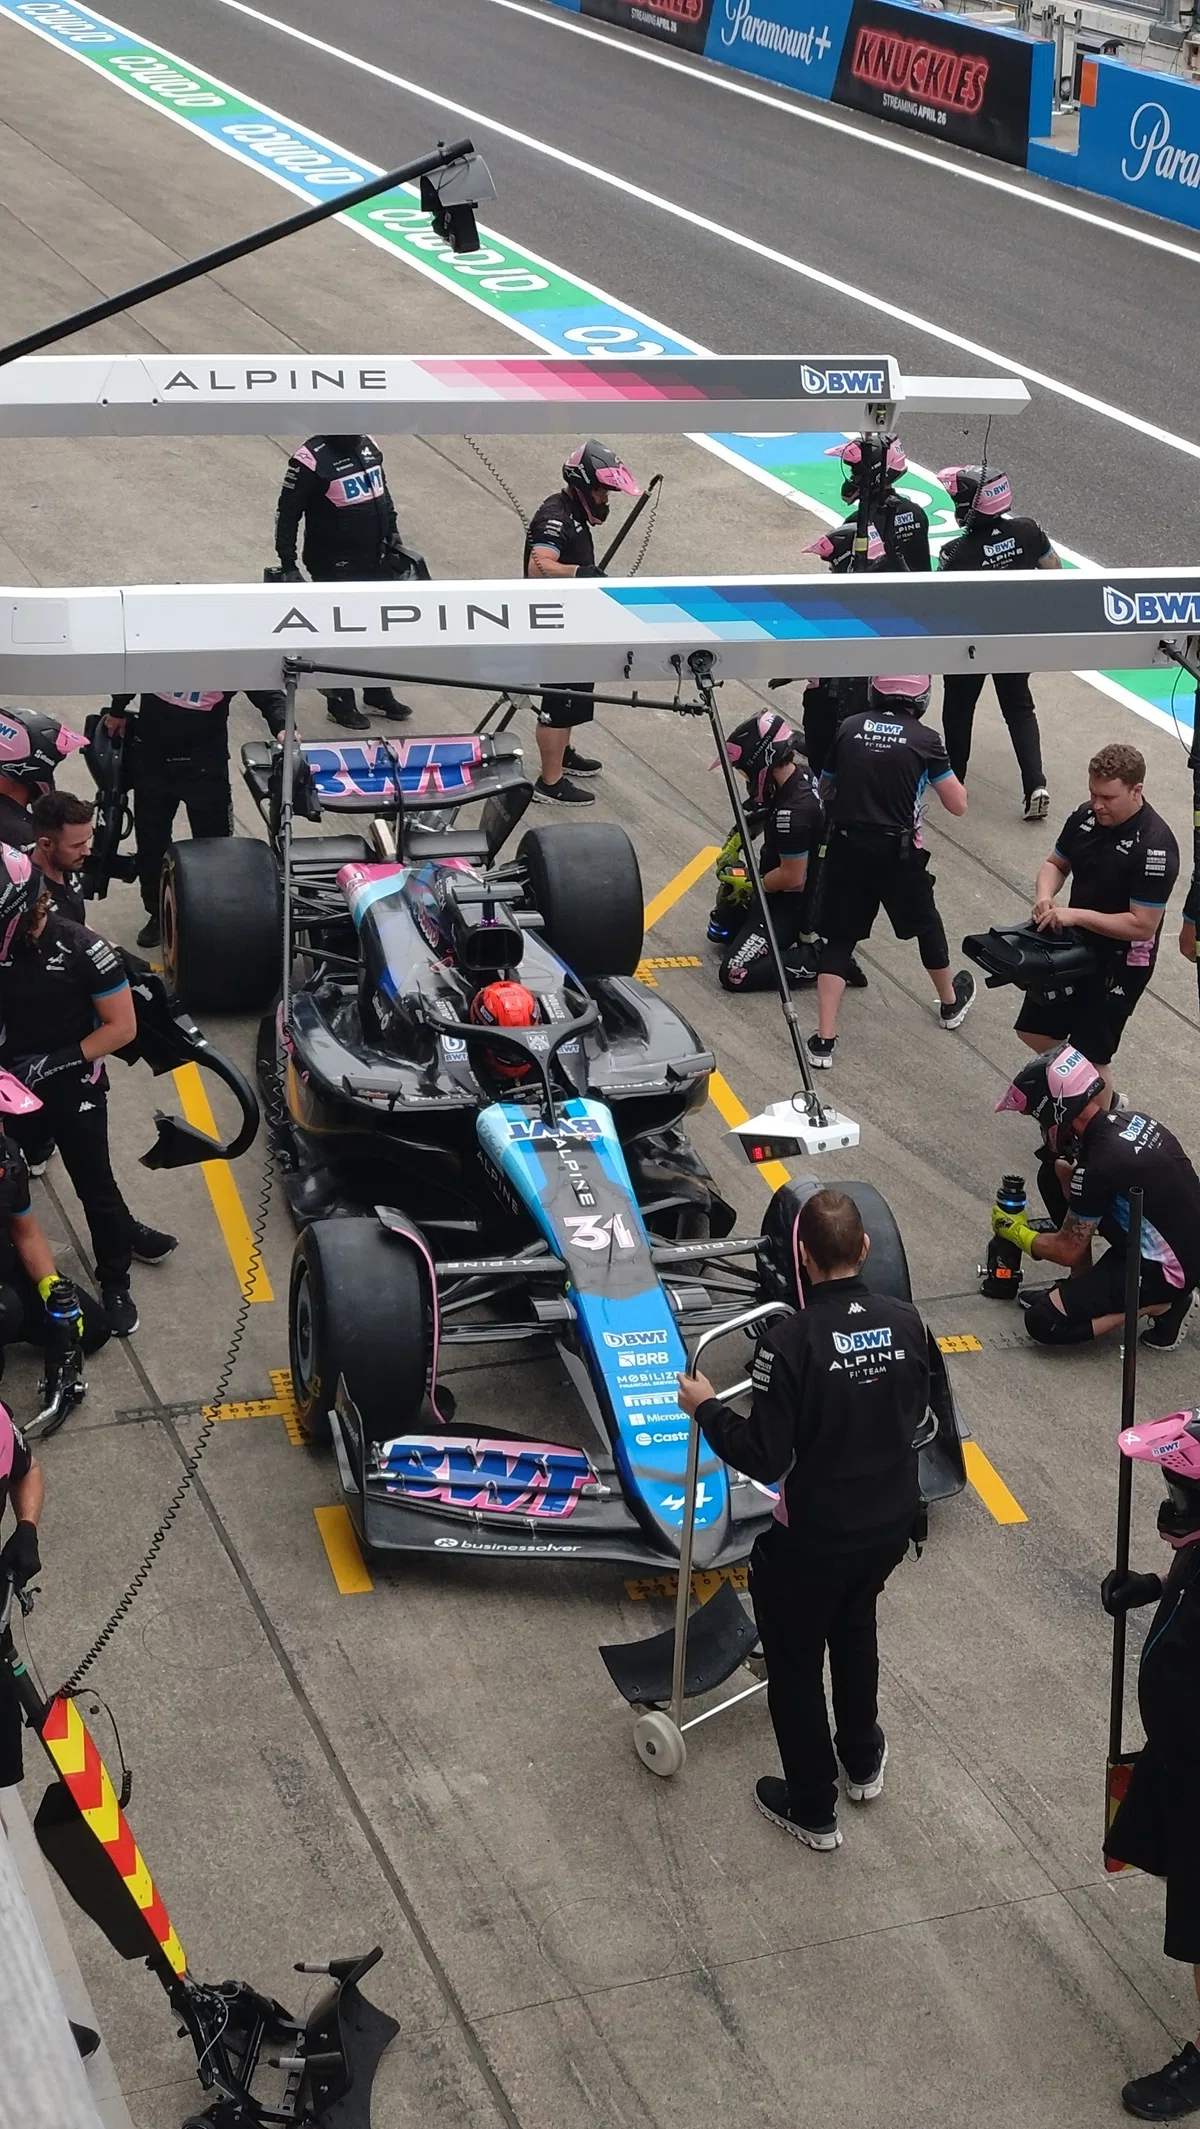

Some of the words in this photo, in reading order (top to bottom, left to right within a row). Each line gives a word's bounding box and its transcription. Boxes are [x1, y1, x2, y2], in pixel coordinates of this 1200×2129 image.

[631, 7, 656, 27] STREAMING
[656, 16, 670, 32] APRIL
[721, 0, 831, 65] Paramount+
[852, 28, 989, 113] KNUCKLES
[882, 92, 918, 117] STREAMING
[917, 104, 936, 122] APRIL
[936, 112, 947, 125] 26
[1121, 102, 1200, 188] Para
[163, 370, 387, 390] ALPINE
[826, 370, 884, 394] BWT
[993, 481, 1010, 496] BWT
[993, 537, 1016, 553] BWT
[982, 547, 1024, 566] ALPINE
[272, 602, 566, 634] ALPINE
[0, 723, 18, 741] WT
[853, 733, 908, 744] ALPINE
[874, 722, 903, 735] BWT
[302, 742, 479, 796] BWT
[444, 1052, 468, 1062] BWT
[1134, 1120, 1158, 1154] ALPINE
[551, 1137, 596, 1206] ALPINE
[476, 1151, 520, 1215] ALPINE
[563, 1213, 635, 1251] 31
[447, 1259, 535, 1269] ALPINE
[621, 1330, 668, 1347] BWT
[851, 1327, 892, 1350] BWT
[636, 1352, 669, 1366] BRB
[828, 1350, 905, 1372] ALPINE
[863, 1366, 887, 1376] TEAM
[647, 1413, 690, 1423] Microso
[653, 1431, 689, 1443] Castr
[1160, 1441, 1180, 1455] BWT
[385, 1443, 593, 1518] BWT
[460, 1540, 582, 1552] businessolver
